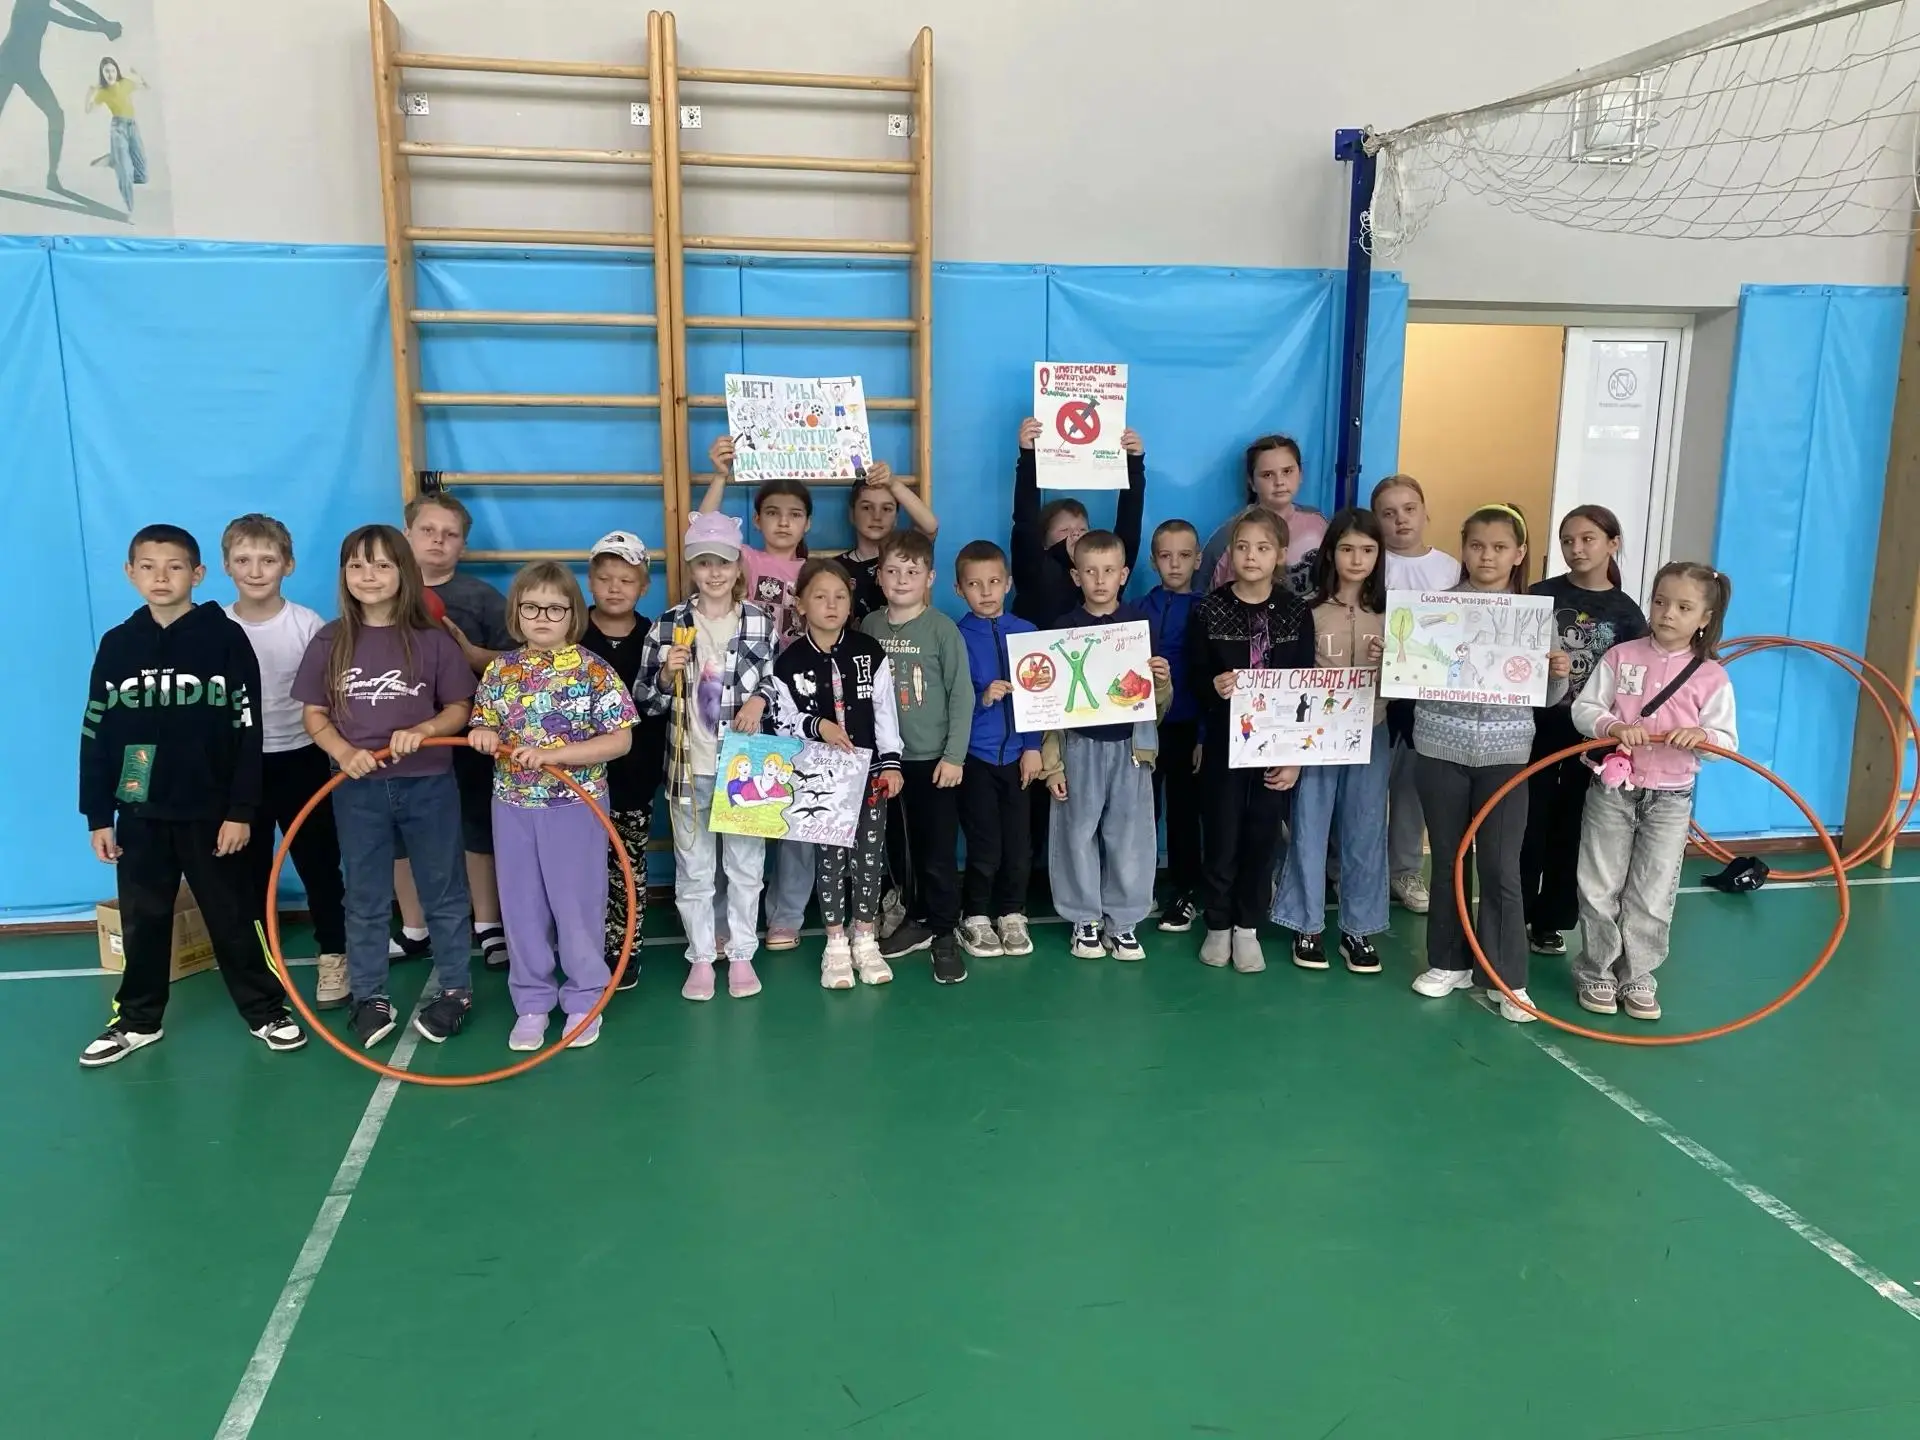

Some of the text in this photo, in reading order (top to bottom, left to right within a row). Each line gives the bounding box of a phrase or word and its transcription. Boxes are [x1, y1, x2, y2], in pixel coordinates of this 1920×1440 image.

[742, 380, 816, 400] НЕТ! МЫ
[780, 429, 837, 445] ПРОТИВ
[740, 452, 827, 471] НАРКОТИКОВ
[1289, 669, 1345, 689] СКАЗАТЬ
[1347, 669, 1377, 689] НЕТ
